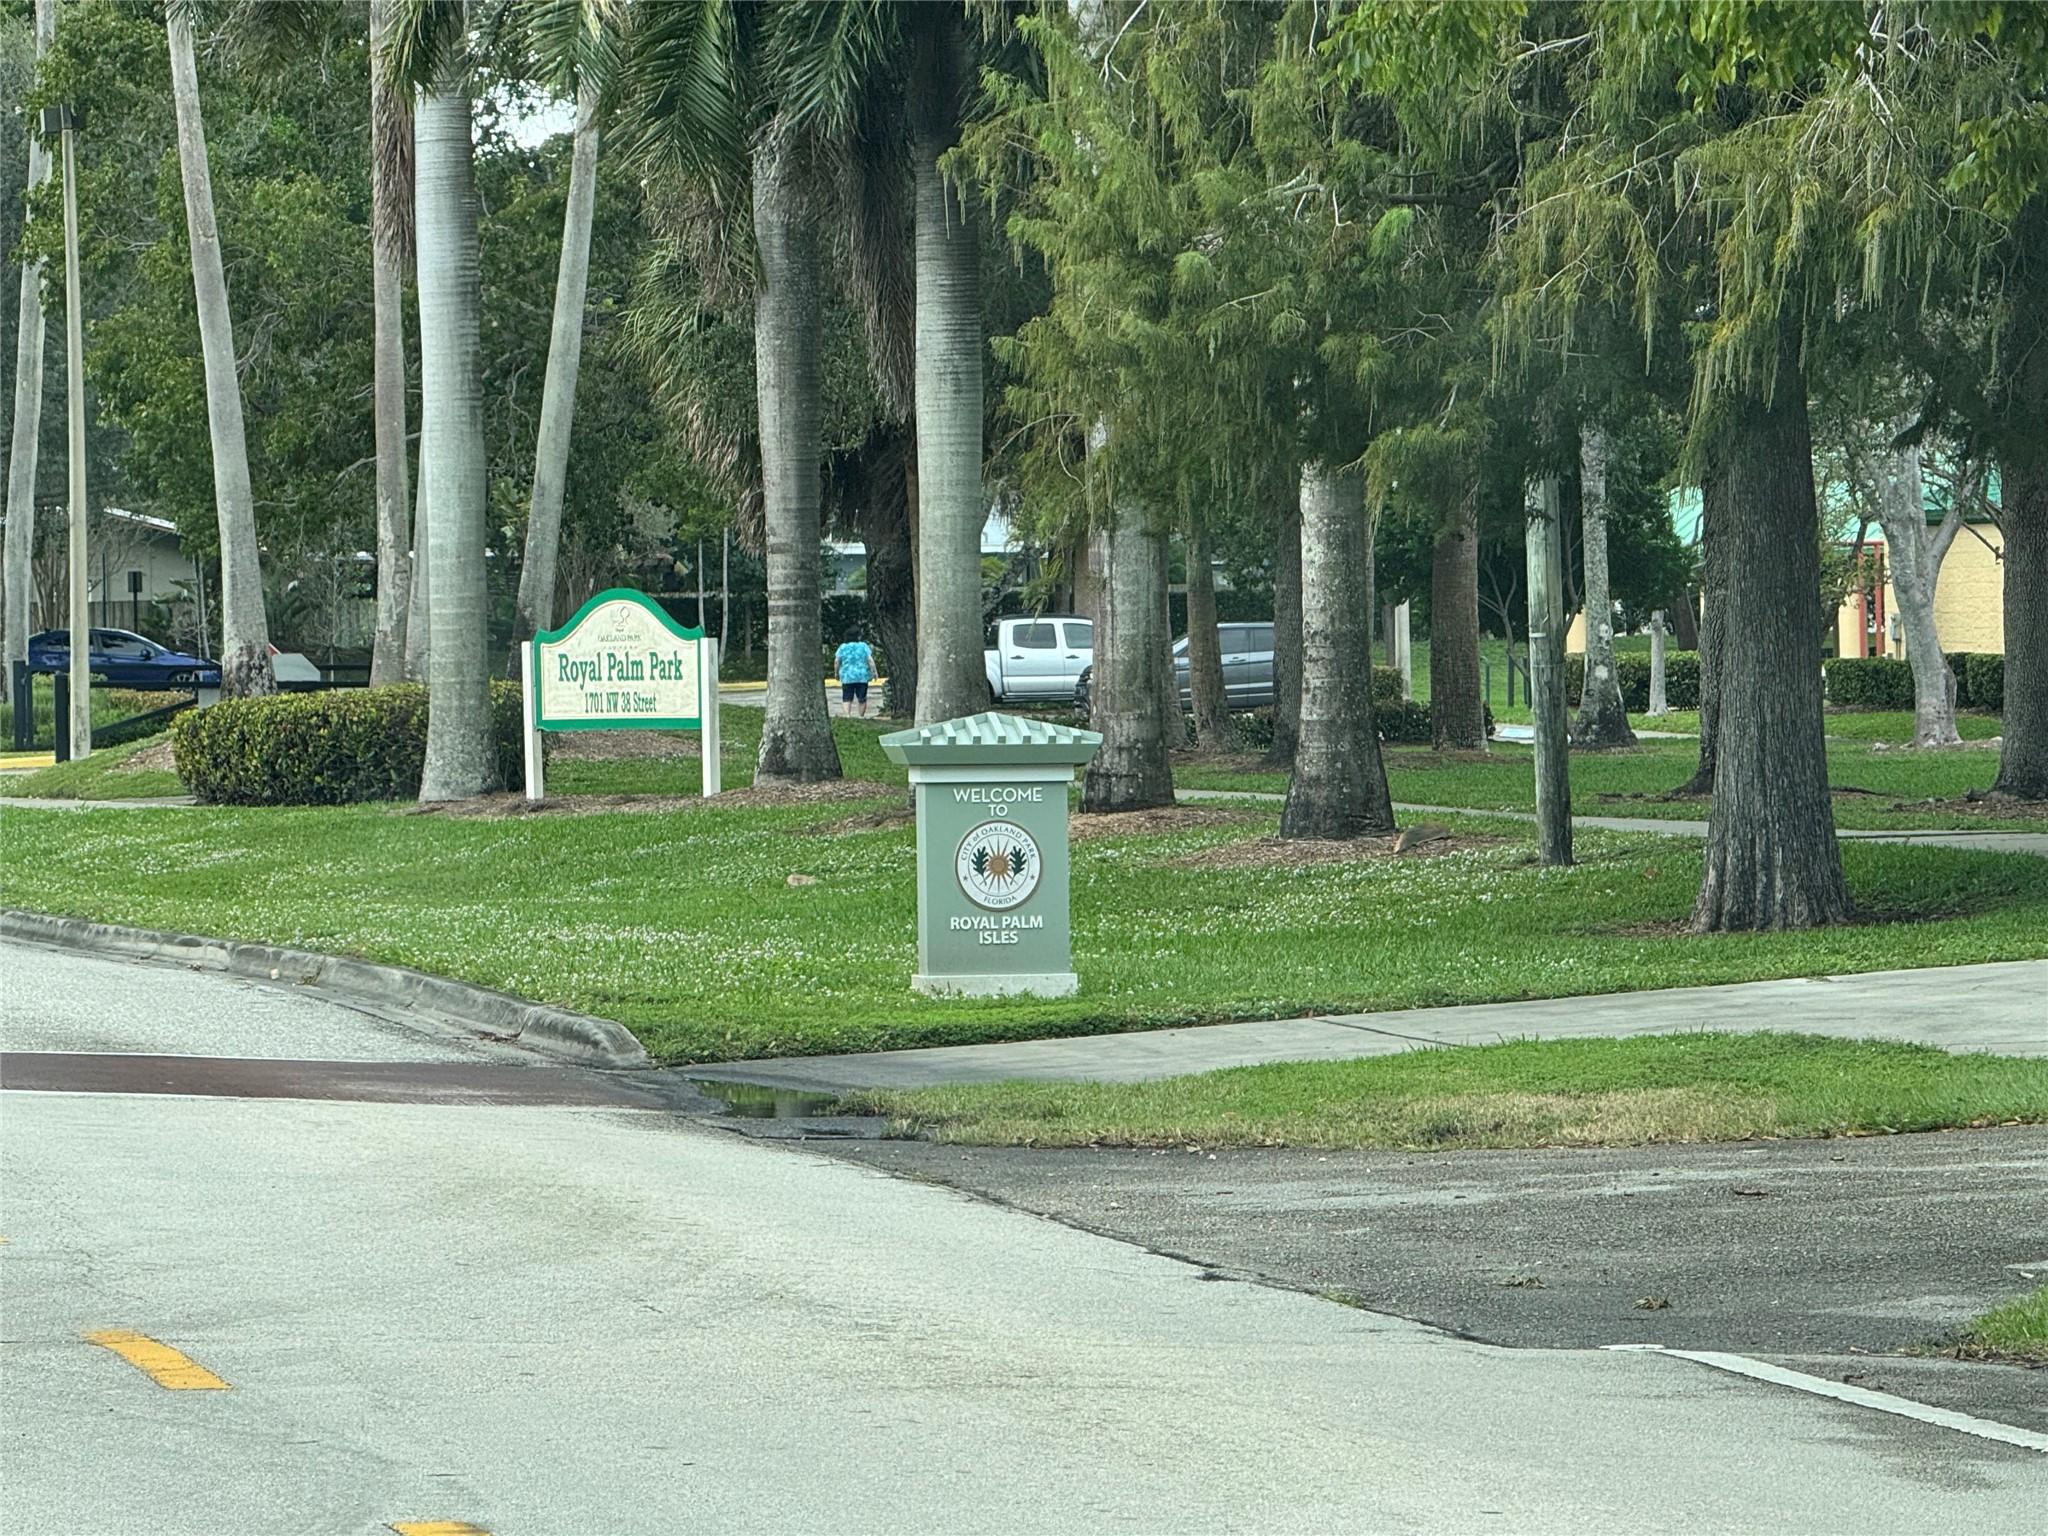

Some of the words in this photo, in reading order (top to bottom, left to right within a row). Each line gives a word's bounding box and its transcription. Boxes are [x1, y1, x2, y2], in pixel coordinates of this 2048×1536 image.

[558, 651, 602, 690] Royal
[607, 651, 644, 681] Palm
[649, 651, 683, 681] Park
[585, 692, 604, 713] 1701
[606, 692, 619, 713] NW
[621, 692, 631, 712] 38
[633, 692, 657, 713] Street
[953, 787, 1043, 803] WELCOME
[988, 804, 1008, 816] TO
[961, 842, 974, 861] CITY
[981, 825, 1022, 839] OAKLAND
[1022, 838, 1036, 859] PARK
[983, 895, 1017, 905] FLORIDA
[950, 916, 999, 930] ROYAL
[1002, 915, 1043, 929] PALM
[979, 931, 1019, 945] ISLES
